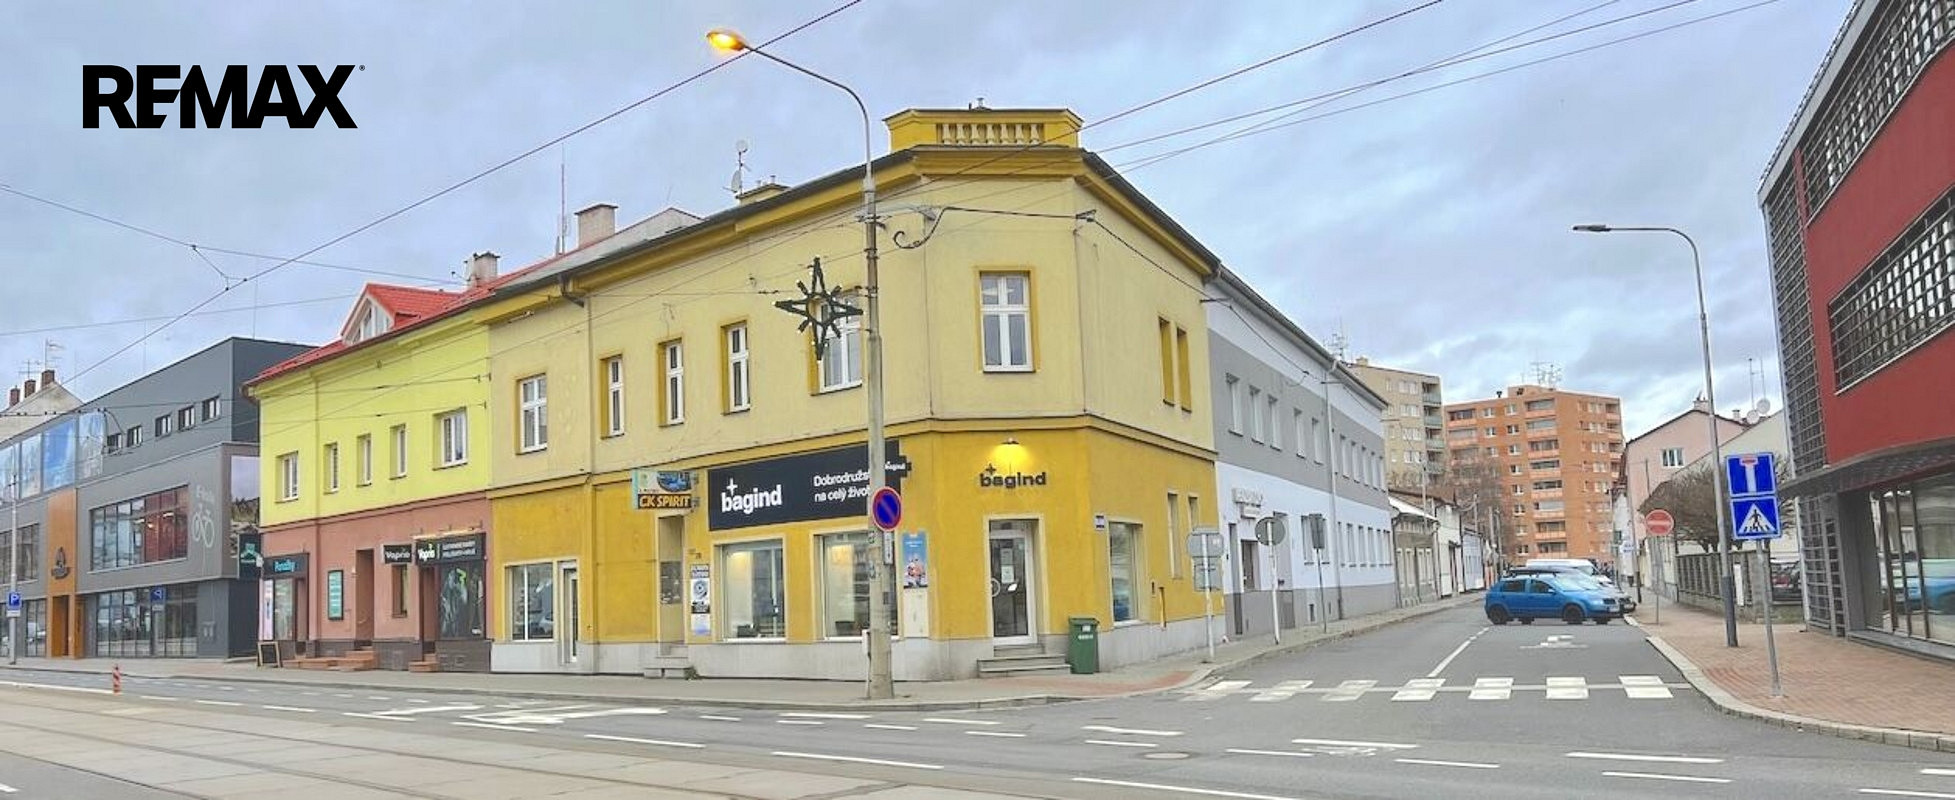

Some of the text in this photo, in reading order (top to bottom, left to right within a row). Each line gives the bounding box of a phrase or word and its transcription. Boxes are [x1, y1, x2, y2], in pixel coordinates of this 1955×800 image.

[980, 472, 1046, 488] bagind
[640, 495, 690, 508] CK SPIRIT
[721, 484, 782, 514] bagind
[814, 492, 827, 503] na
[828, 488, 847, 502] celý
[10, 593, 20, 606] P
